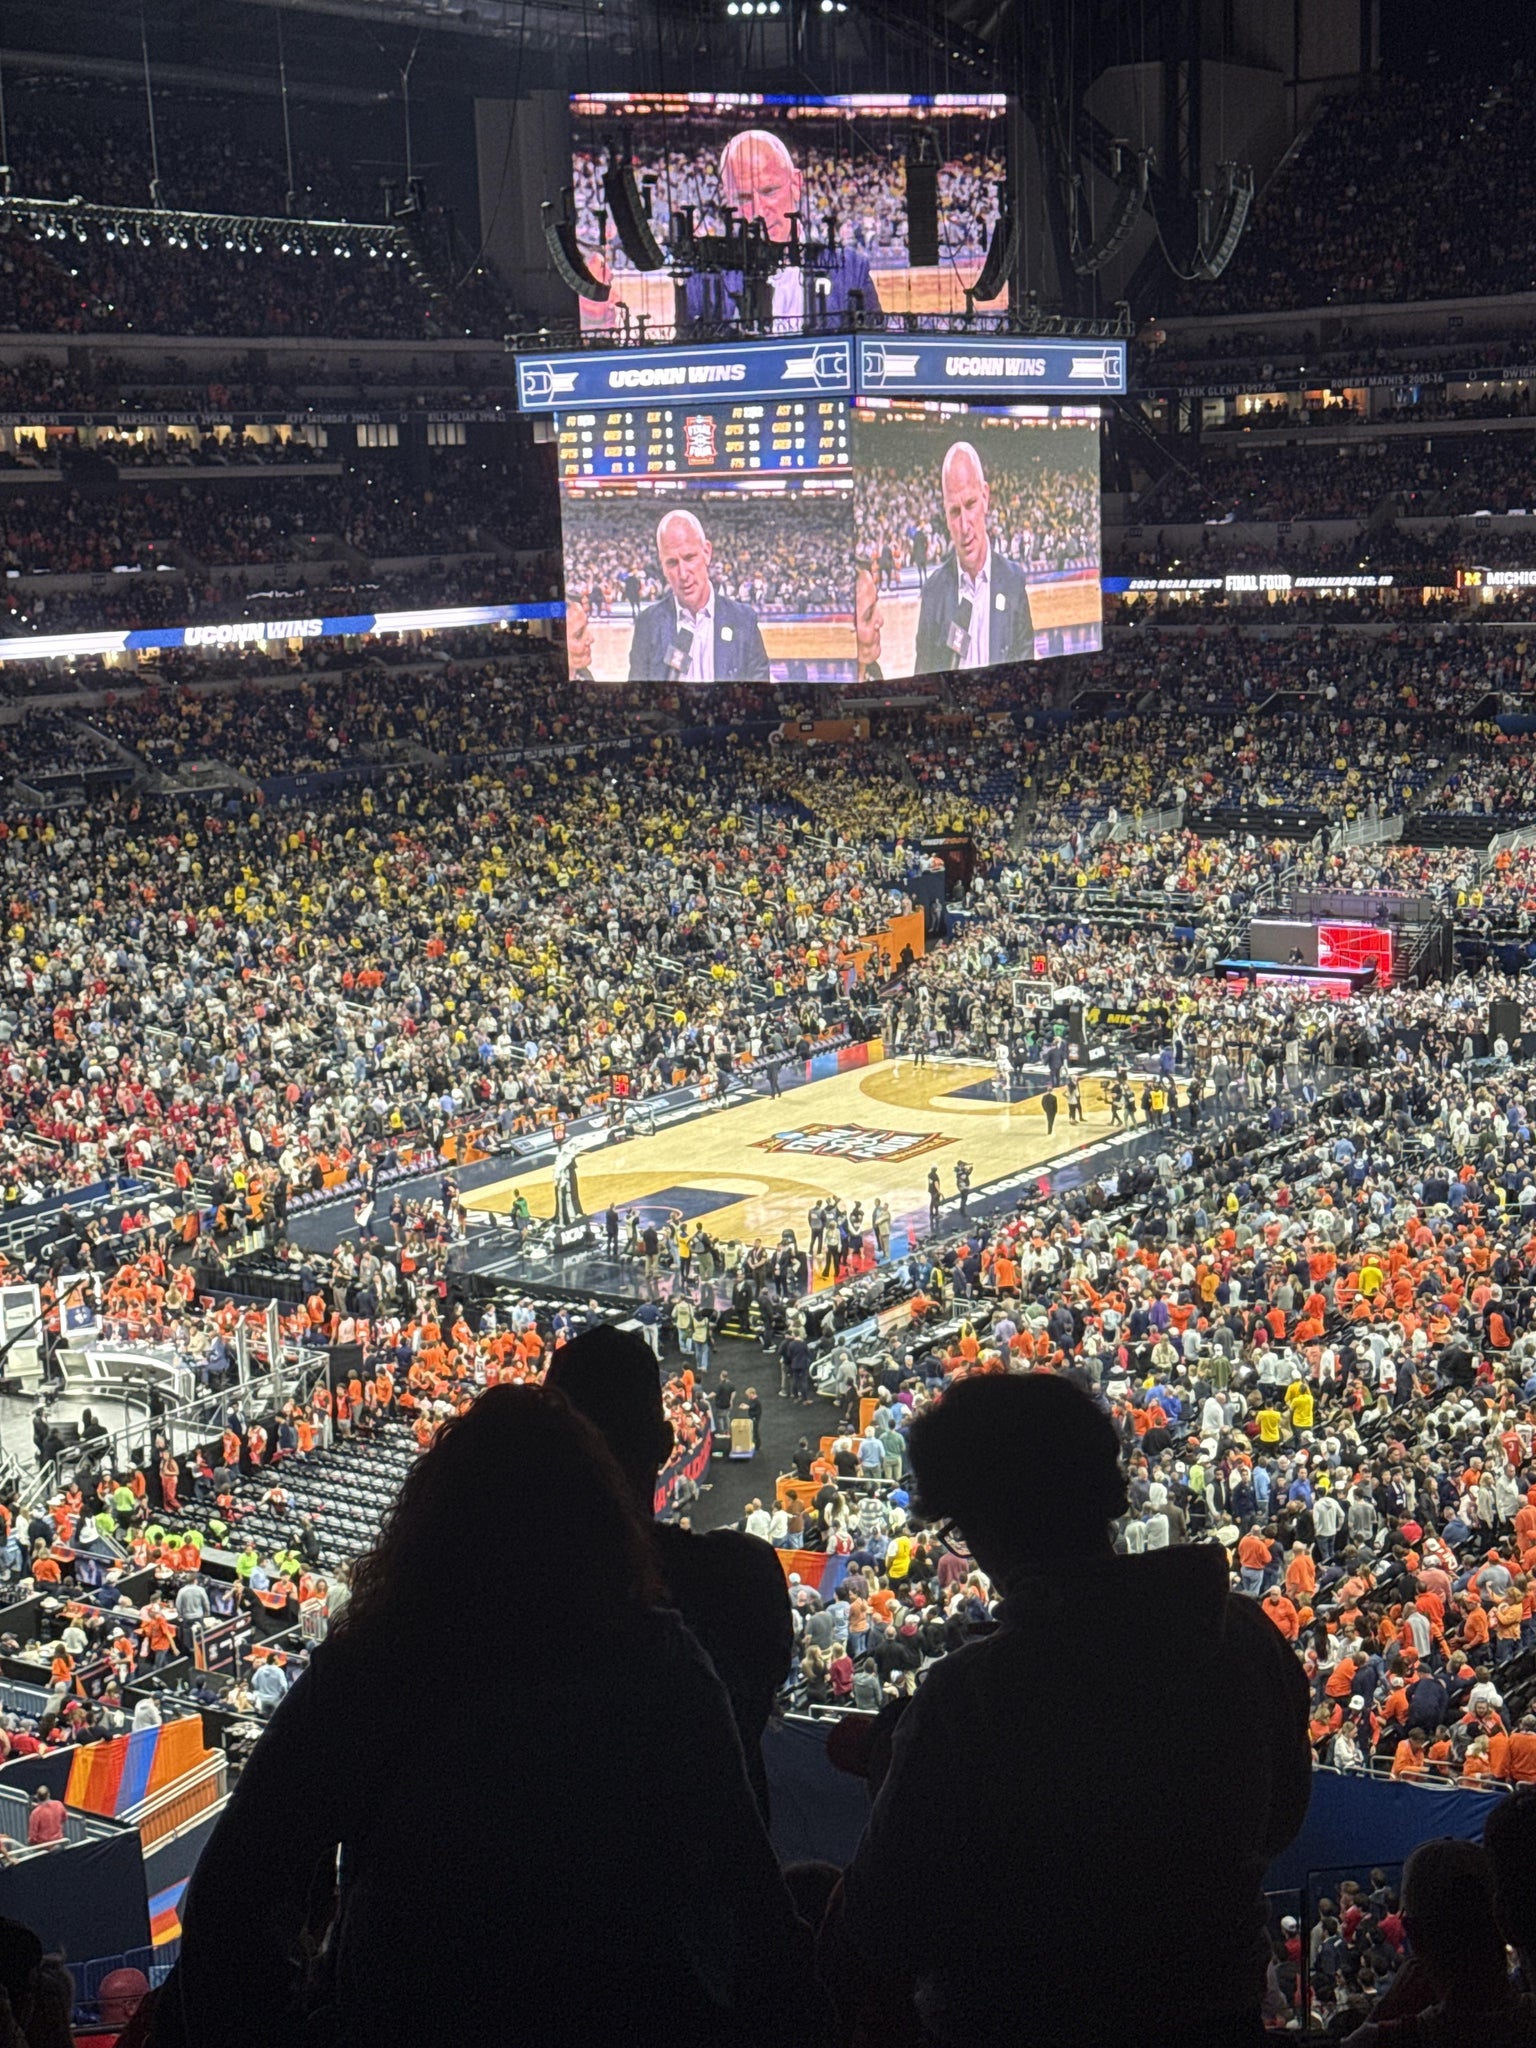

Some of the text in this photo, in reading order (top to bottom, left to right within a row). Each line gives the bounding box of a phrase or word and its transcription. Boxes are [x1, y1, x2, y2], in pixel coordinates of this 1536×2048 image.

[946, 357, 1046, 376] UCONN WINS
[608, 364, 746, 388] UCONN WINS
[1331, 378, 1367, 389] ROBERT
[1369, 376, 1404, 387] MATHIS
[1178, 388, 1202, 397] TARIK
[1207, 386, 1239, 396] GLENN
[117, 415, 166, 424] MARSHALL
[307, 413, 347, 424] SATURDAY
[1158, 579, 1188, 589] NCAA
[1189, 578, 1223, 589] MEN'S
[1225, 575, 1258, 591] FINAL
[1260, 574, 1291, 591] FOUR
[1464, 572, 1482, 586] M
[184, 619, 323, 646] UCONN WINS
[782, 1128, 864, 1151] FINAL
[849, 1135, 926, 1158] FOUR
[981, 1166, 1051, 1195] ROAD
[1051, 1142, 1112, 1169] ENDS
